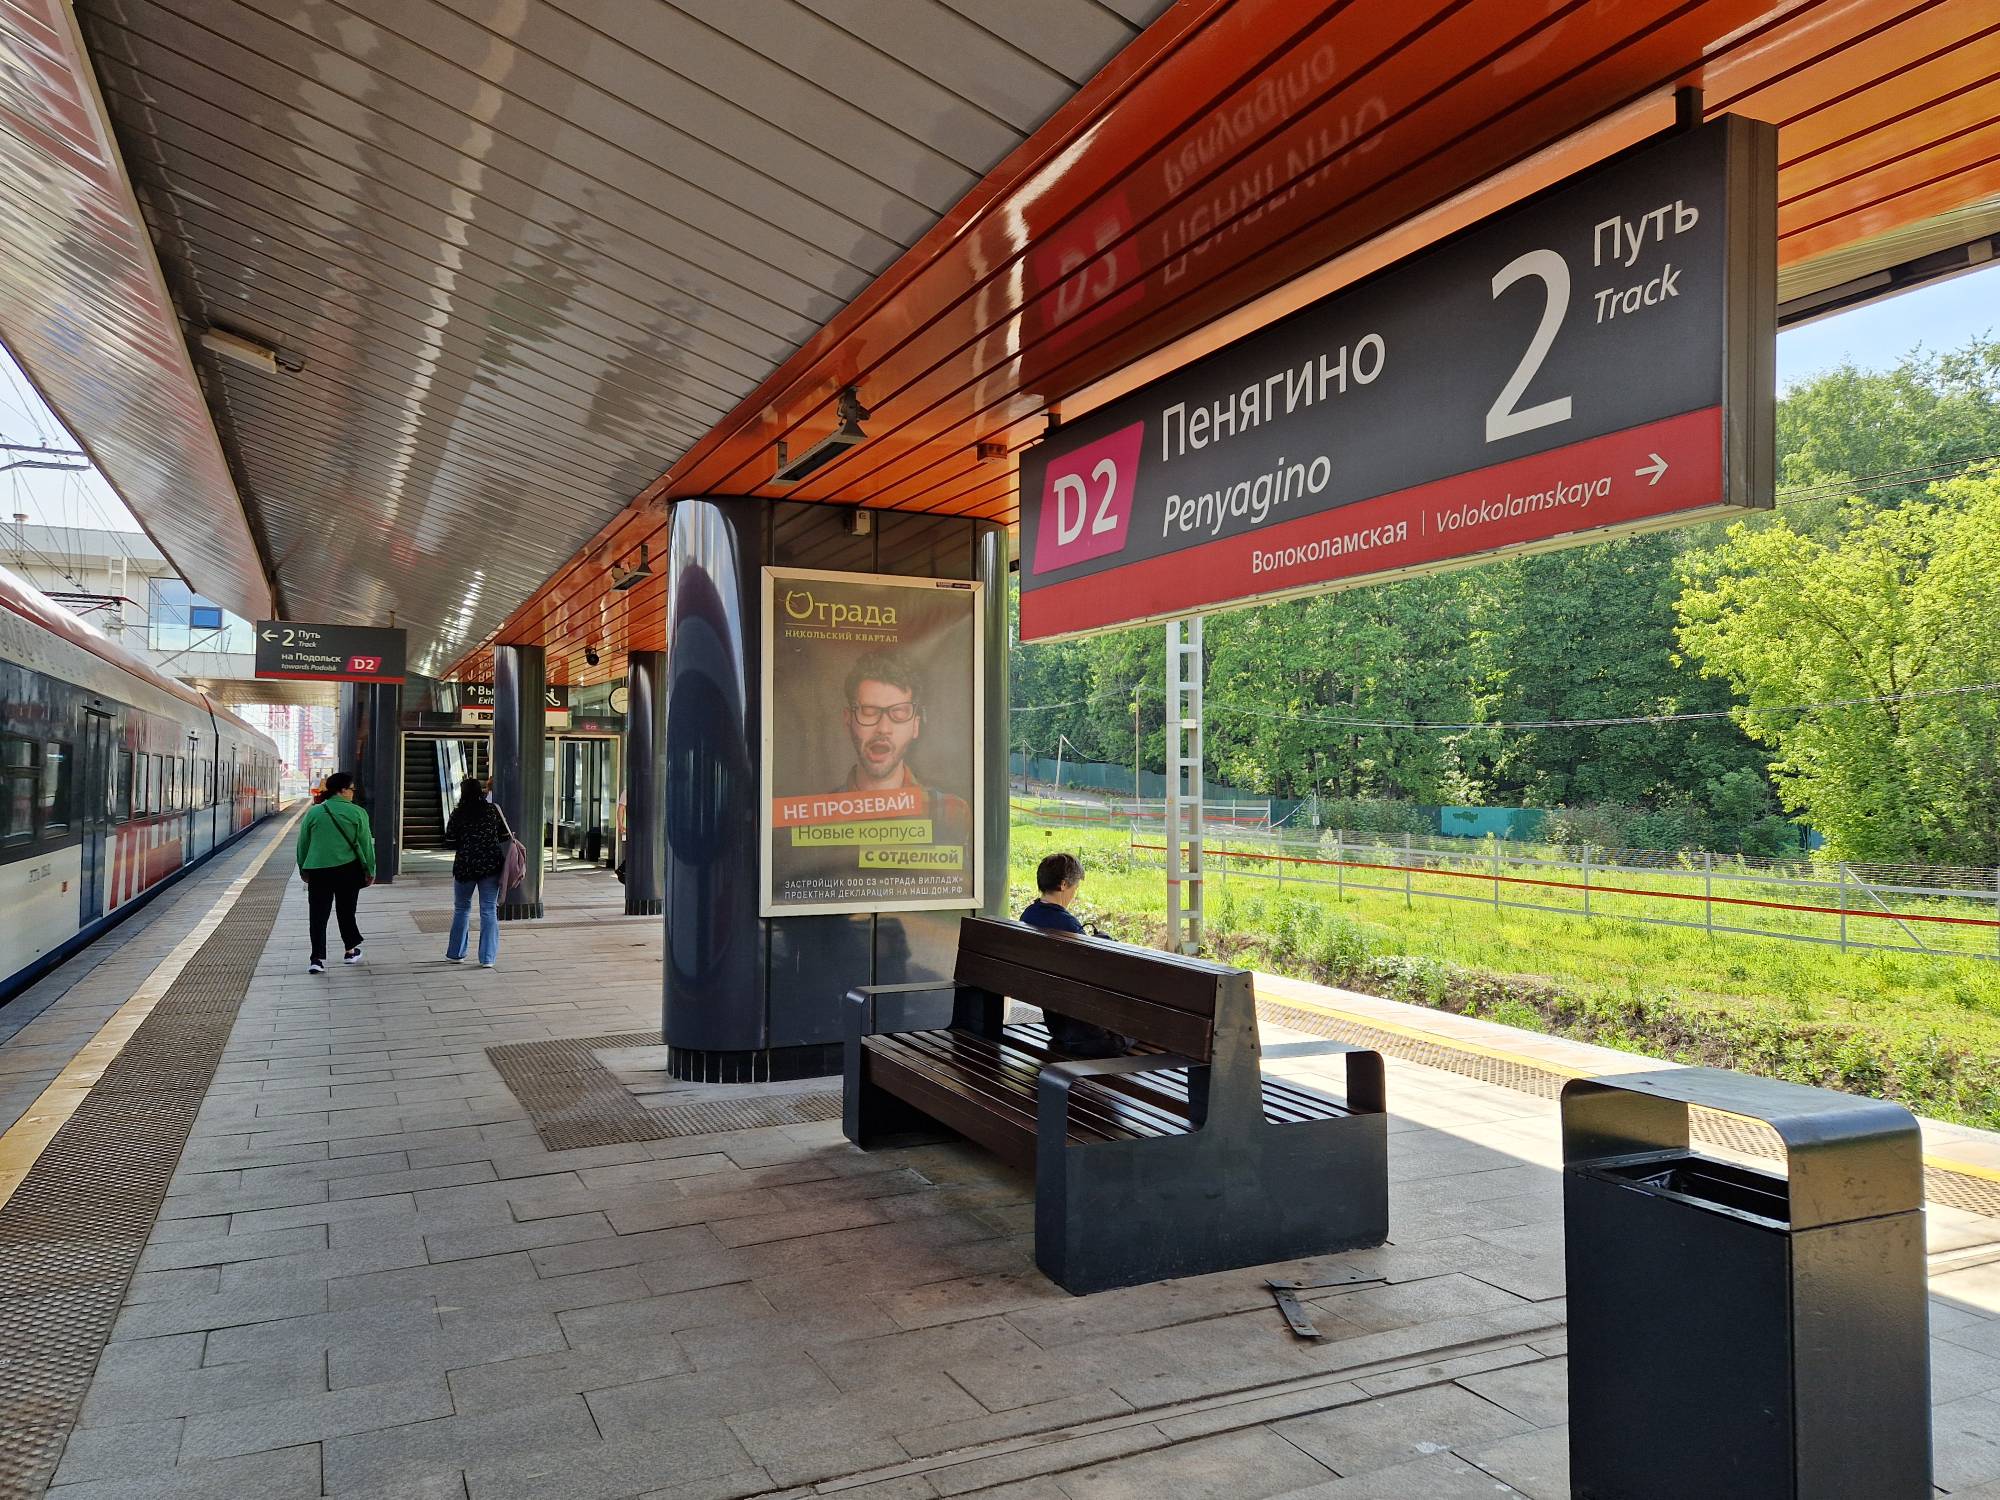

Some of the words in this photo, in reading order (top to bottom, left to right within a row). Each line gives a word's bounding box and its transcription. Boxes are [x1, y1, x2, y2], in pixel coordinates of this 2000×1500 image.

[1593, 200, 1699, 268] Путь
[1594, 264, 1681, 324] Track
[1485, 249, 1572, 443] 2
[1162, 333, 1386, 462] Пенягино
[1053, 458, 1118, 546] D2
[1162, 456, 1331, 537] Penyagino
[1436, 476, 1612, 533] Volokolamskaya
[1252, 520, 1407, 574] Волоколамская
[785, 590, 898, 628] Отрада
[282, 629, 295, 647] 2
[298, 630, 321, 640] Путь
[785, 629, 852, 641] НИКОЛЬСКИЙ
[855, 633, 898, 643] КВАРТАЛ
[298, 641, 318, 649] Track
[296, 653, 342, 663] Подольск
[354, 659, 375, 670] D2
[478, 686, 495, 695] Вы
[783, 803, 809, 820] НЕ
[813, 792, 915, 817] ПРОЗЕВАЙ!
[798, 825, 855, 840] Новые
[859, 825, 926, 842] корпуса
[864, 851, 874, 862] с
[878, 849, 958, 864] отделкой
[785, 878, 844, 889] ЗАСТРОЙЩИК
[785, 889, 837, 900] ПРОЕКТНАЯ
[838, 887, 894, 899] ДЕКЛАРАЦИЯ
[896, 888, 908, 896] НА
